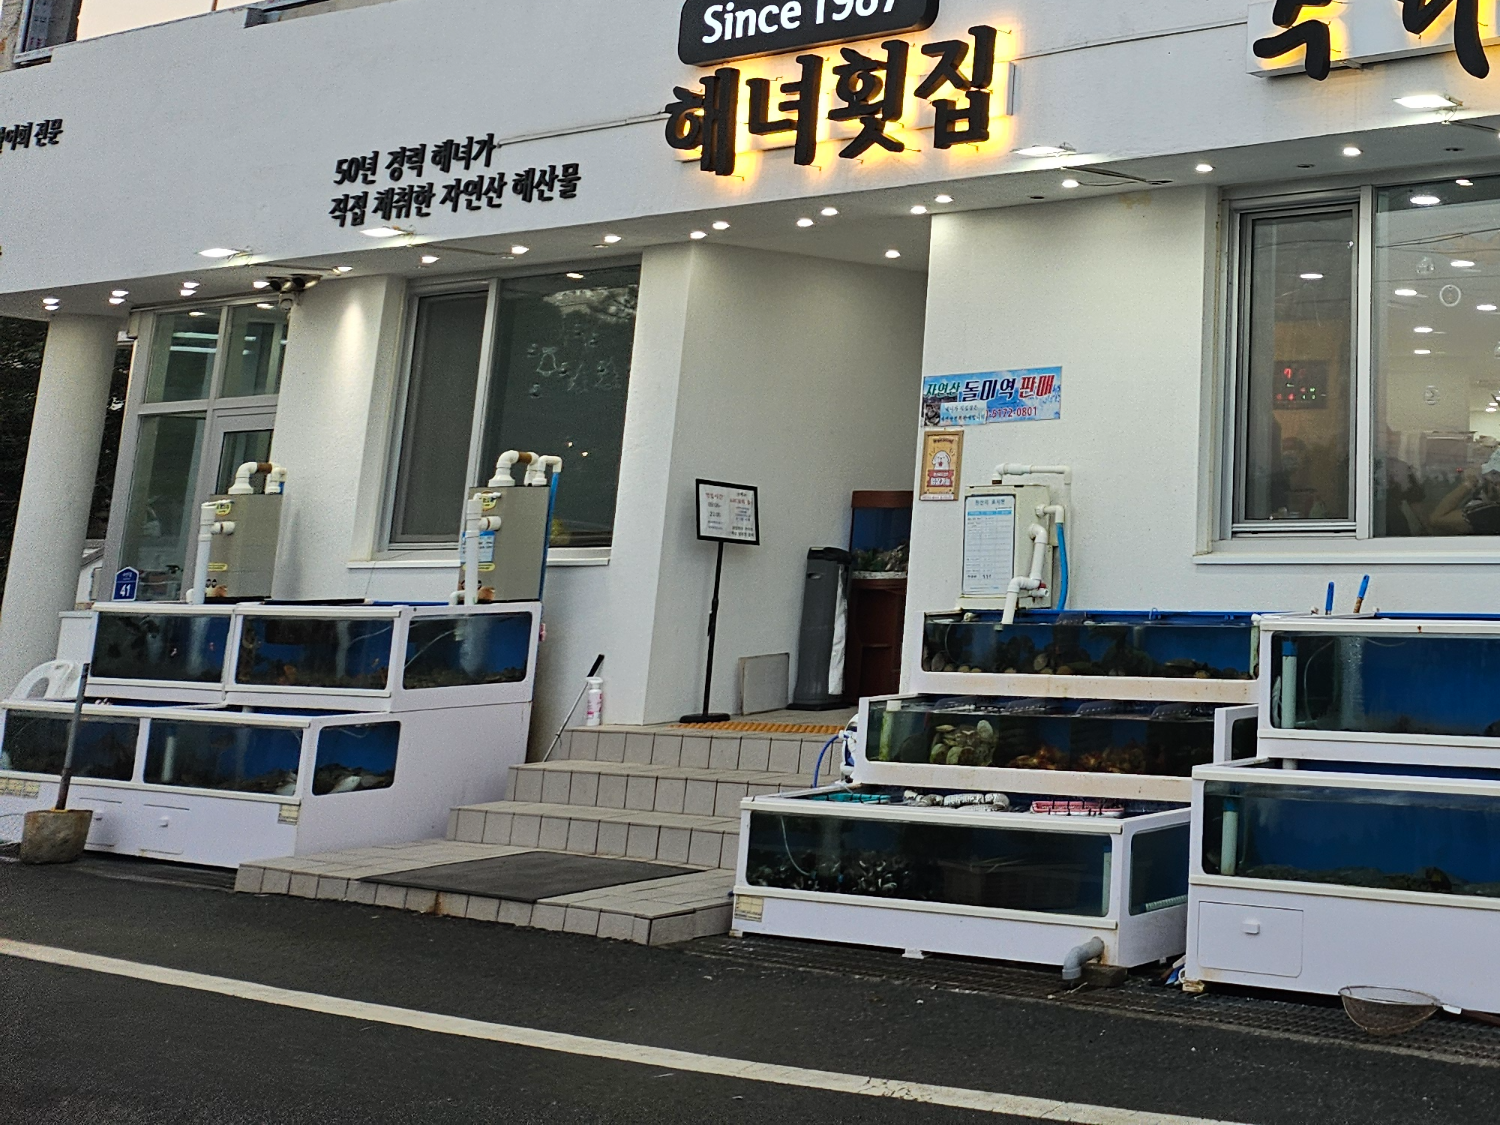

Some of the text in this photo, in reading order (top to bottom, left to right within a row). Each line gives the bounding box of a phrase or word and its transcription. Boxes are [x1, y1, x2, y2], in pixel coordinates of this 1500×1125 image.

[702, 1, 801, 44] Since
[664, 25, 998, 176] 해녀횟집
[34, 118, 64, 147] 전문
[333, 133, 496, 185] 50년 경력 해녀가
[329, 162, 582, 227] 직접 채취한 자연산 해산물
[926, 374, 1055, 402] 자연산 돌미역 판매
[120, 584, 131, 597] 41
